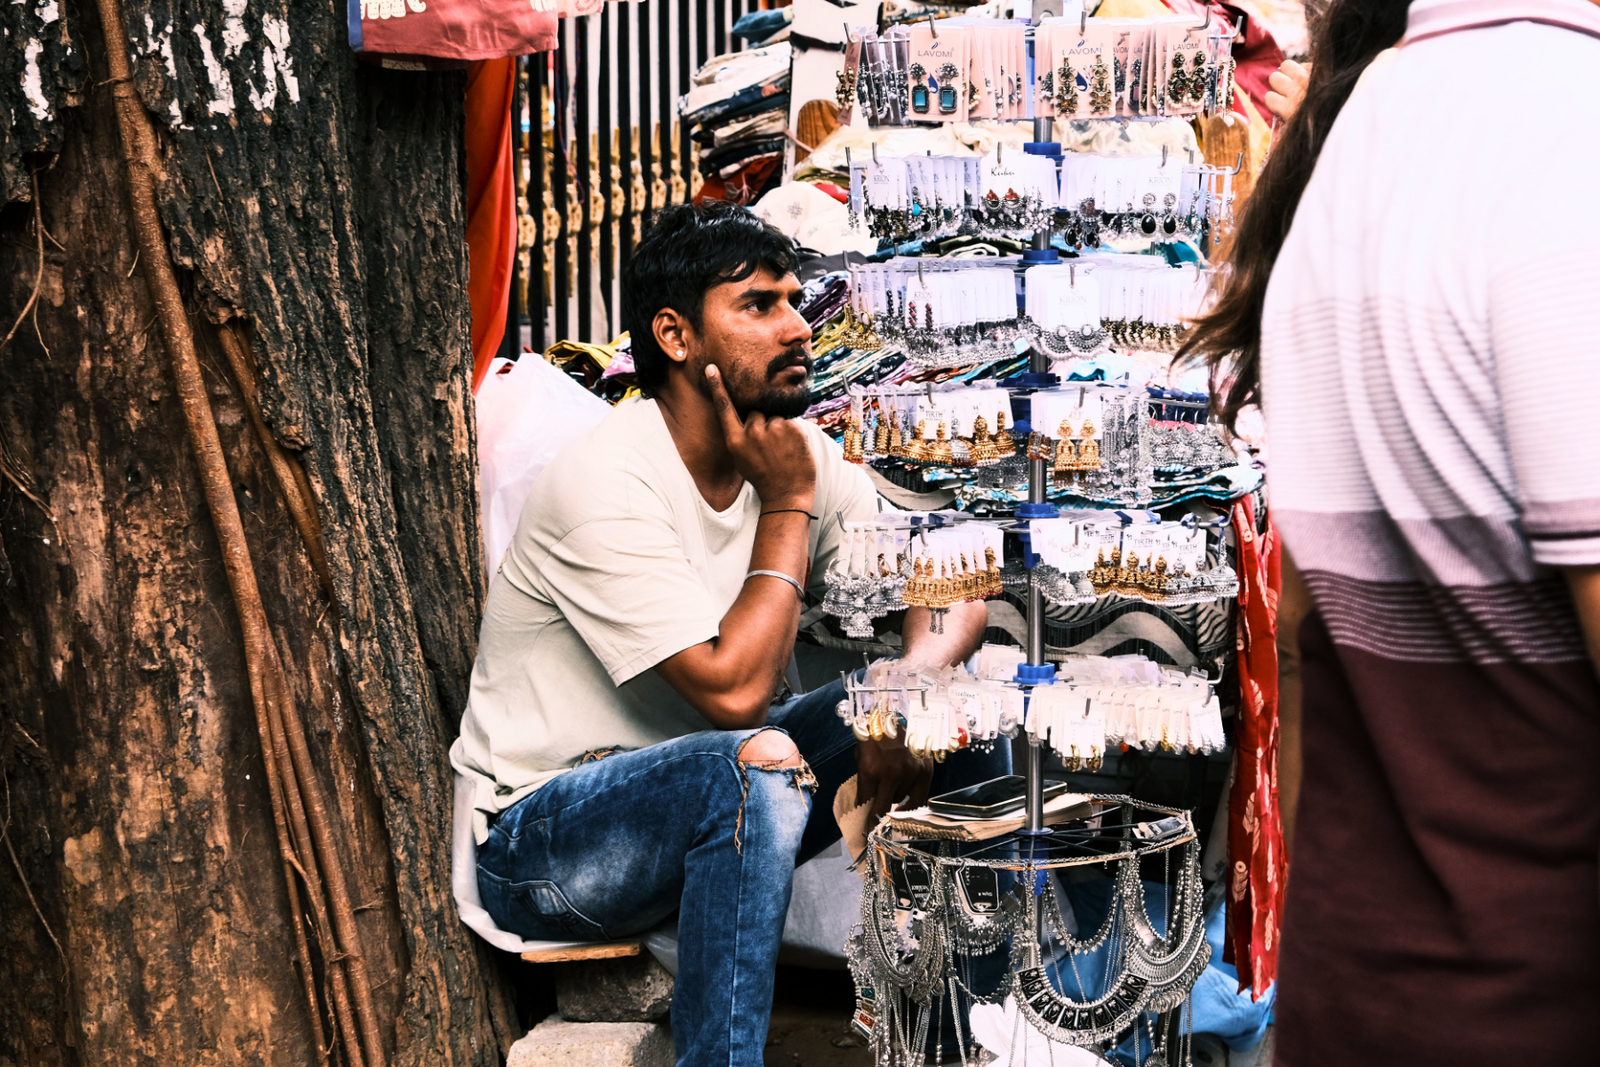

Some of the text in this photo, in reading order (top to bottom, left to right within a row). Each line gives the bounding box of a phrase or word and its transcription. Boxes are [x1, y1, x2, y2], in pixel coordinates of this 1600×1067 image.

[1173, 42, 1199, 51] LAVOMI
[1148, 176, 1174, 185] KRION
[1059, 295, 1087, 304] KRION
[925, 410, 943, 418] TIRTH
[1134, 538, 1153, 546] TIRTH
